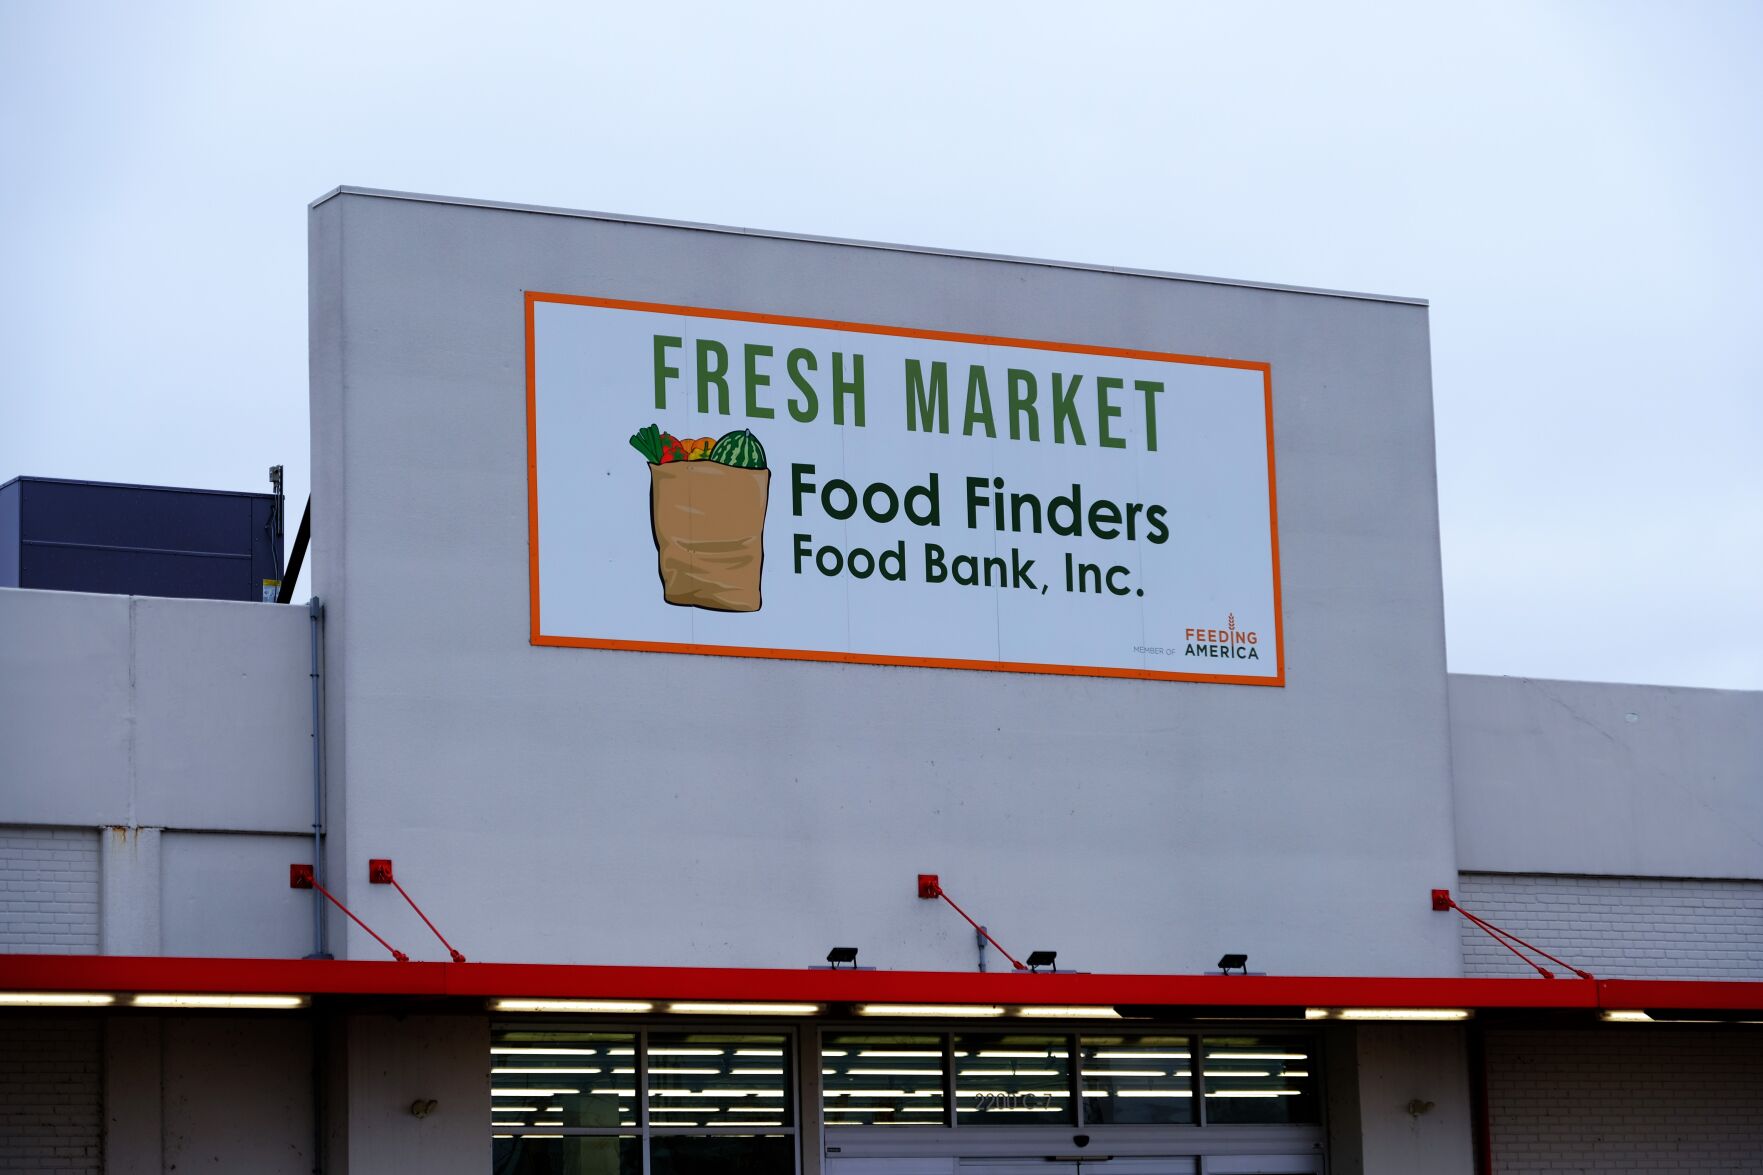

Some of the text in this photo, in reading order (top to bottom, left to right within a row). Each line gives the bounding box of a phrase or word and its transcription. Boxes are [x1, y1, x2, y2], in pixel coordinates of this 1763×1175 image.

[653, 334, 1165, 452] FRESH MARKET
[791, 462, 1170, 545] Food Finders
[793, 532, 1145, 598] Food Bank, Inc.
[1133, 646, 1176, 656] MEMBER OF
[1184, 643, 1259, 660] AMERICA
[1185, 628, 1258, 645] FEEDING
